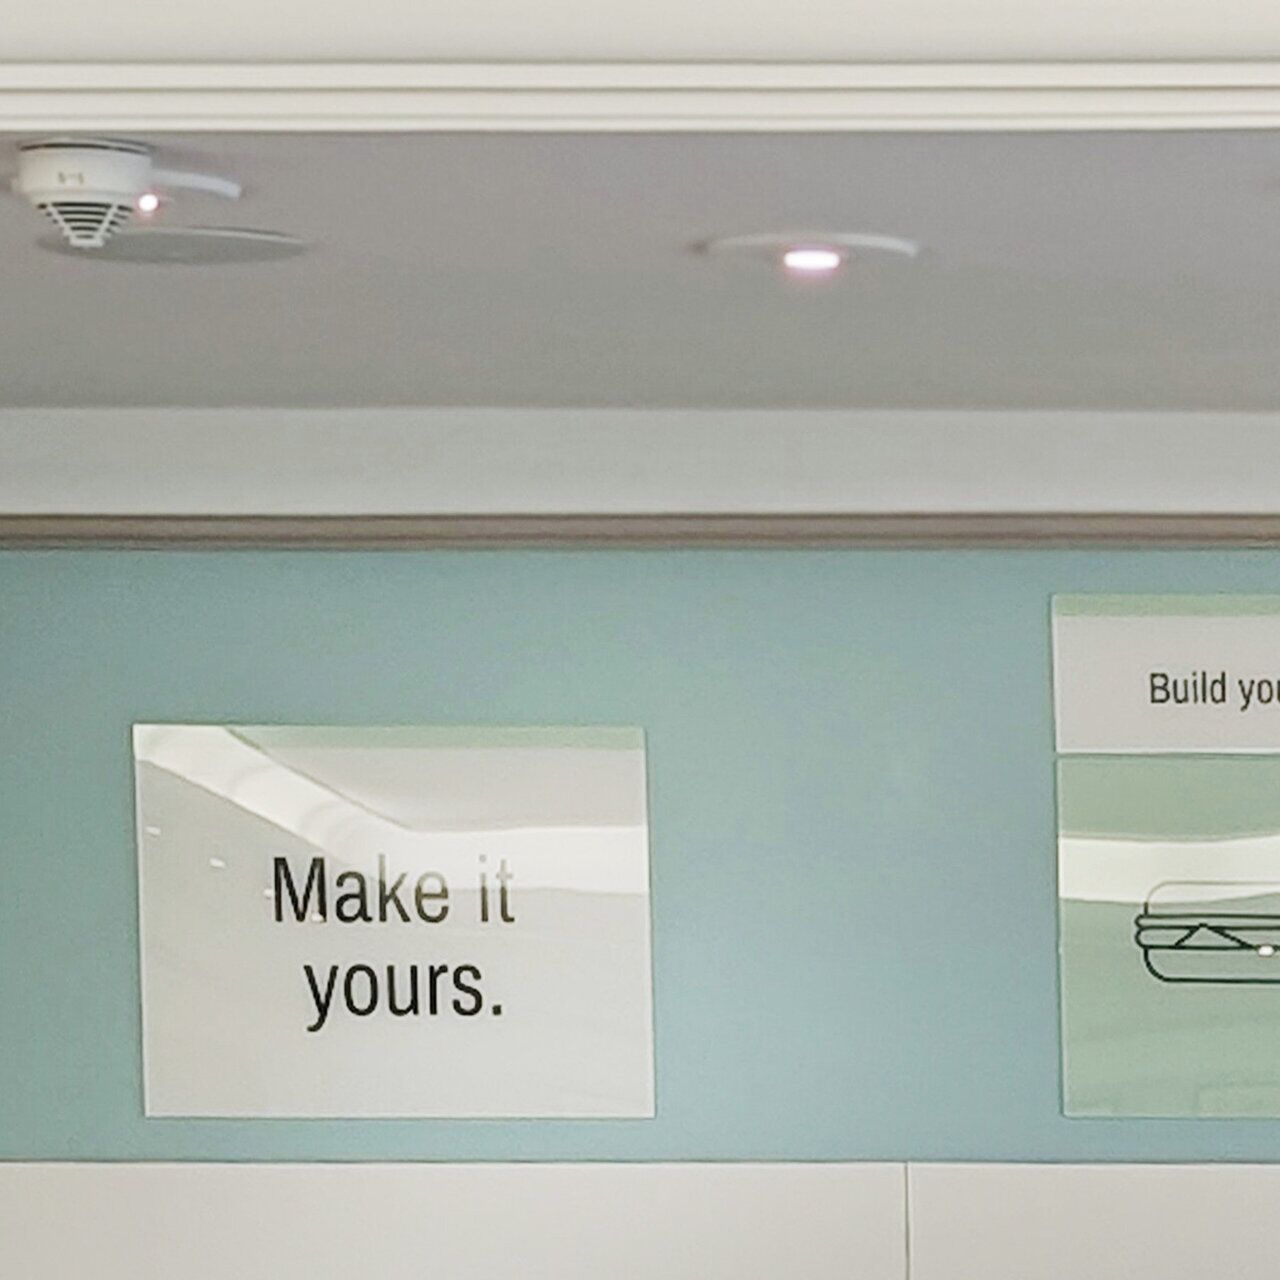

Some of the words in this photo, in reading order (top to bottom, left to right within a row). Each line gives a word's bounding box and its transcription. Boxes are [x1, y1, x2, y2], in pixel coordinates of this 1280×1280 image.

[1149, 670, 1227, 705] Build
[273, 854, 450, 924] Make
[479, 854, 516, 924] it
[302, 963, 502, 1033] yours.
